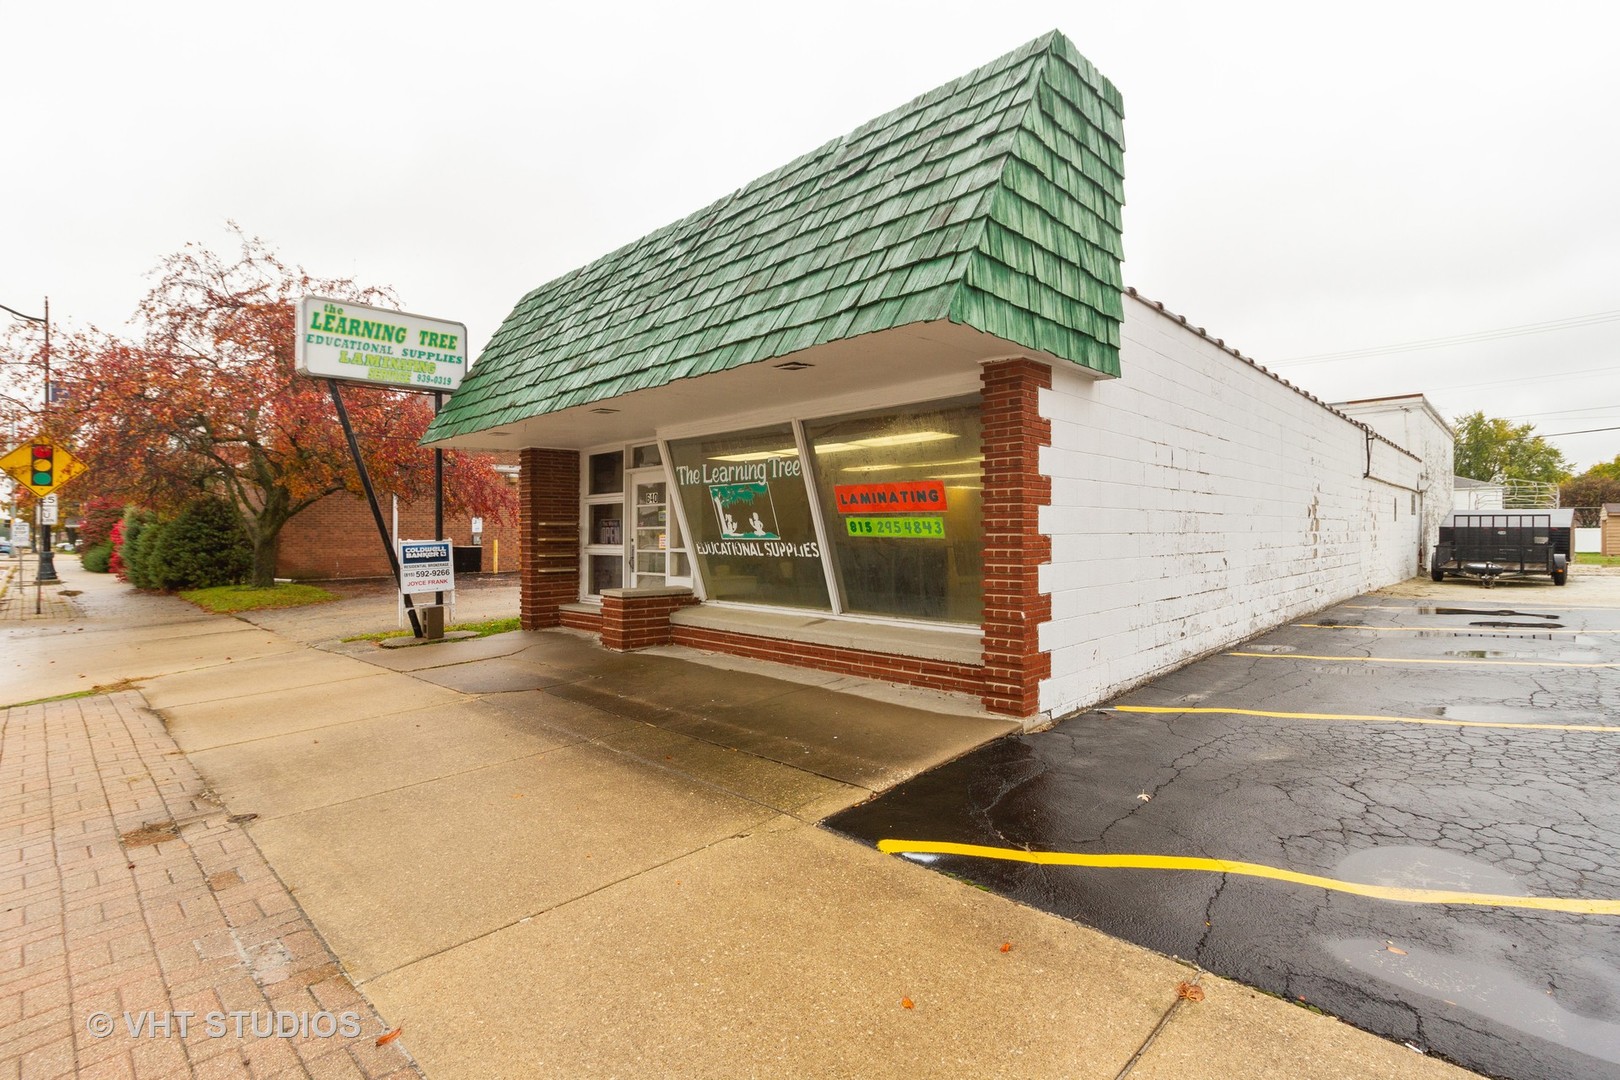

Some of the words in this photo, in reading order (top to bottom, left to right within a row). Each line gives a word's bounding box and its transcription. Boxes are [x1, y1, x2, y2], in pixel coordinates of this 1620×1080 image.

[323, 303, 344, 315] the
[310, 311, 407, 344] LEARNING
[419, 330, 458, 350] TREE
[306, 333, 394, 355] EDUCATIONAL
[401, 348, 463, 365] SUPPLIES
[338, 350, 437, 374] LAMINATING
[416, 373, 452, 386] 939-0319
[676, 465, 700, 486] The
[702, 460, 767, 485] Learning
[768, 456, 801, 478] Tree
[840, 489, 939, 505] LAMINATING
[877, 521, 902, 534] 295
[904, 521, 943, 534] 4843
[405, 551, 439, 559] BANKER
[696, 541, 764, 557] EDUCATIONAL
[764, 541, 820, 558] SUPPLIES
[416, 569, 451, 578] 592-9266
